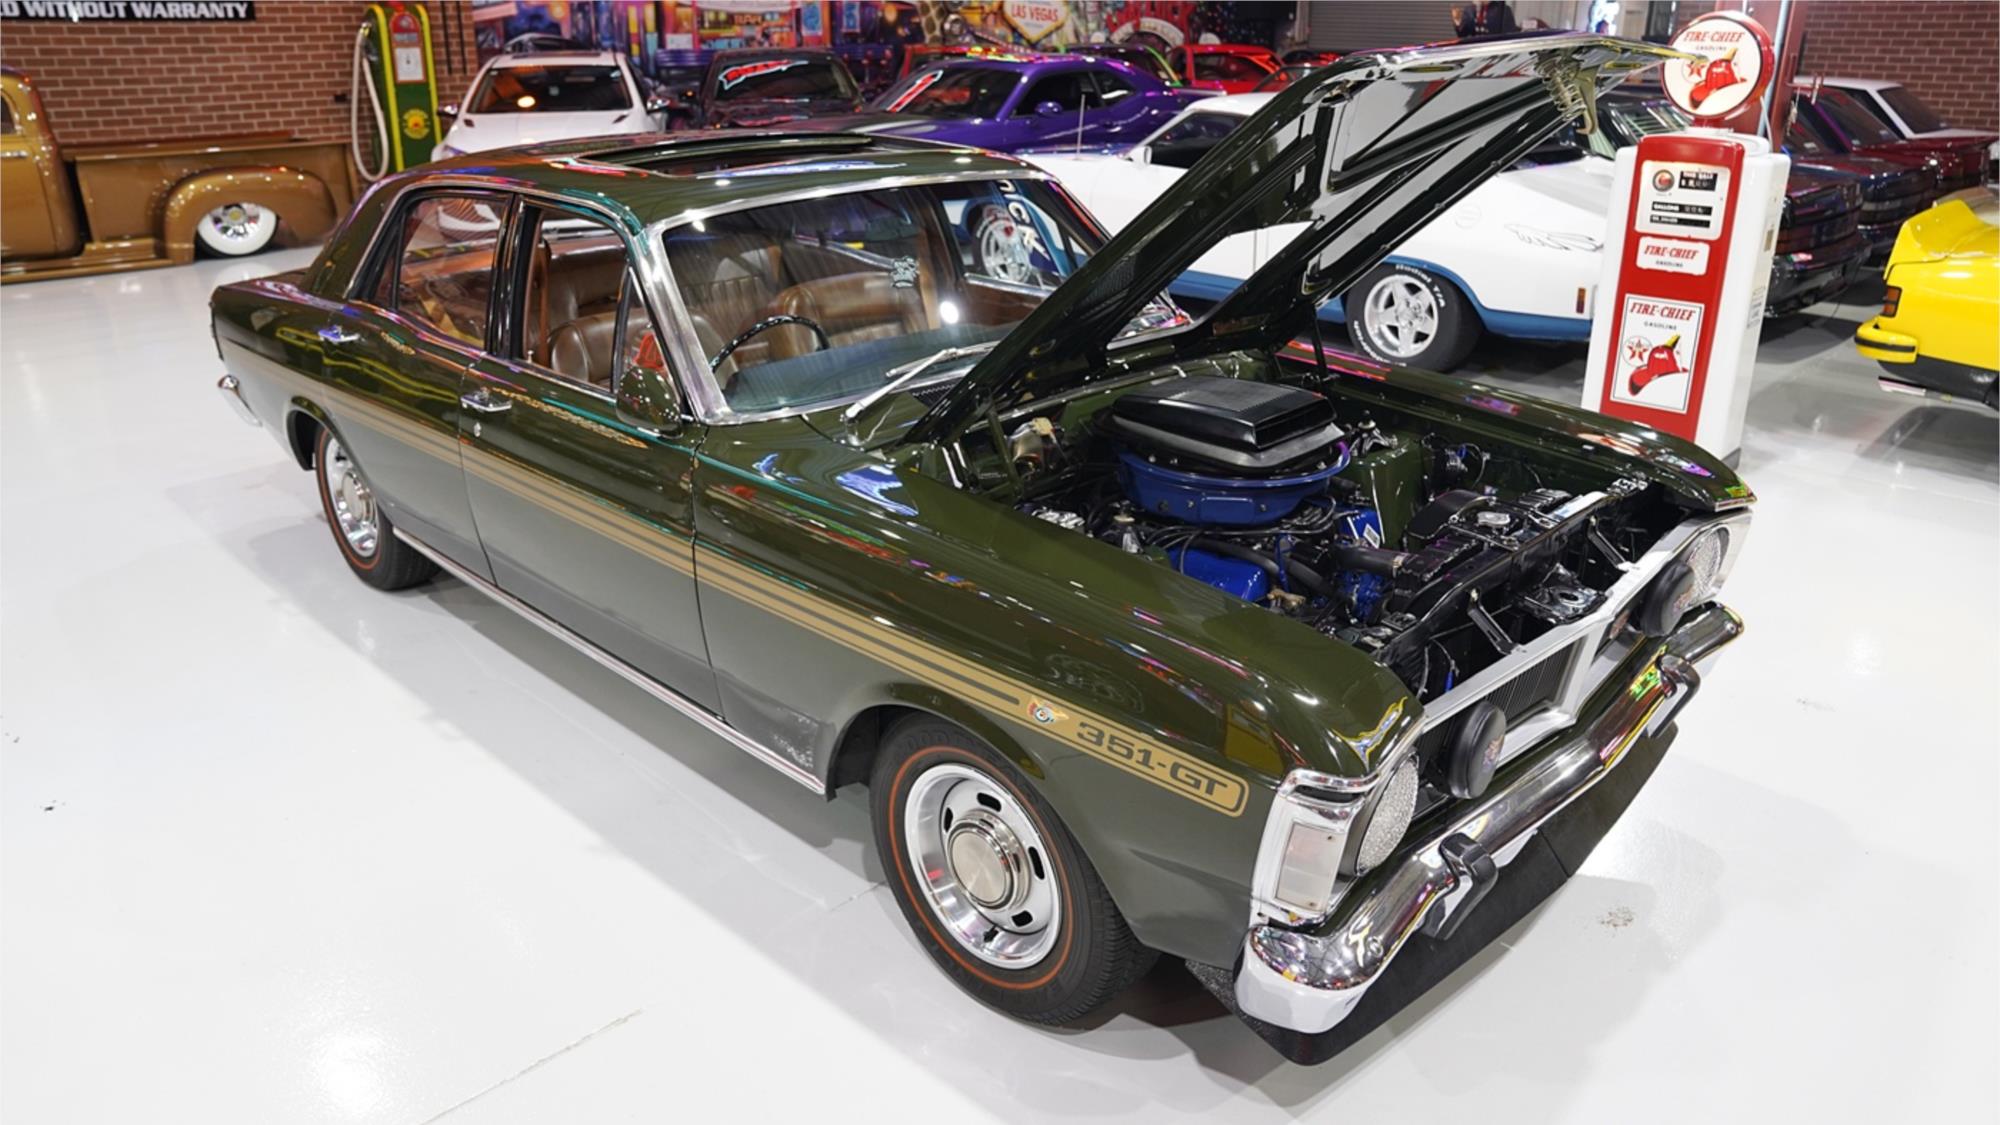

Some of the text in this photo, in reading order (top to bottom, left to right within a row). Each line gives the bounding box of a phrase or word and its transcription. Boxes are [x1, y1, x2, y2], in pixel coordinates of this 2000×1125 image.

[23, 1, 127, 18] WITHOUT
[130, 2, 248, 18] WARRANTY
[1011, 4, 1059, 22] LAS VEGAS
[1076, 721, 1229, 796] 351-GT
